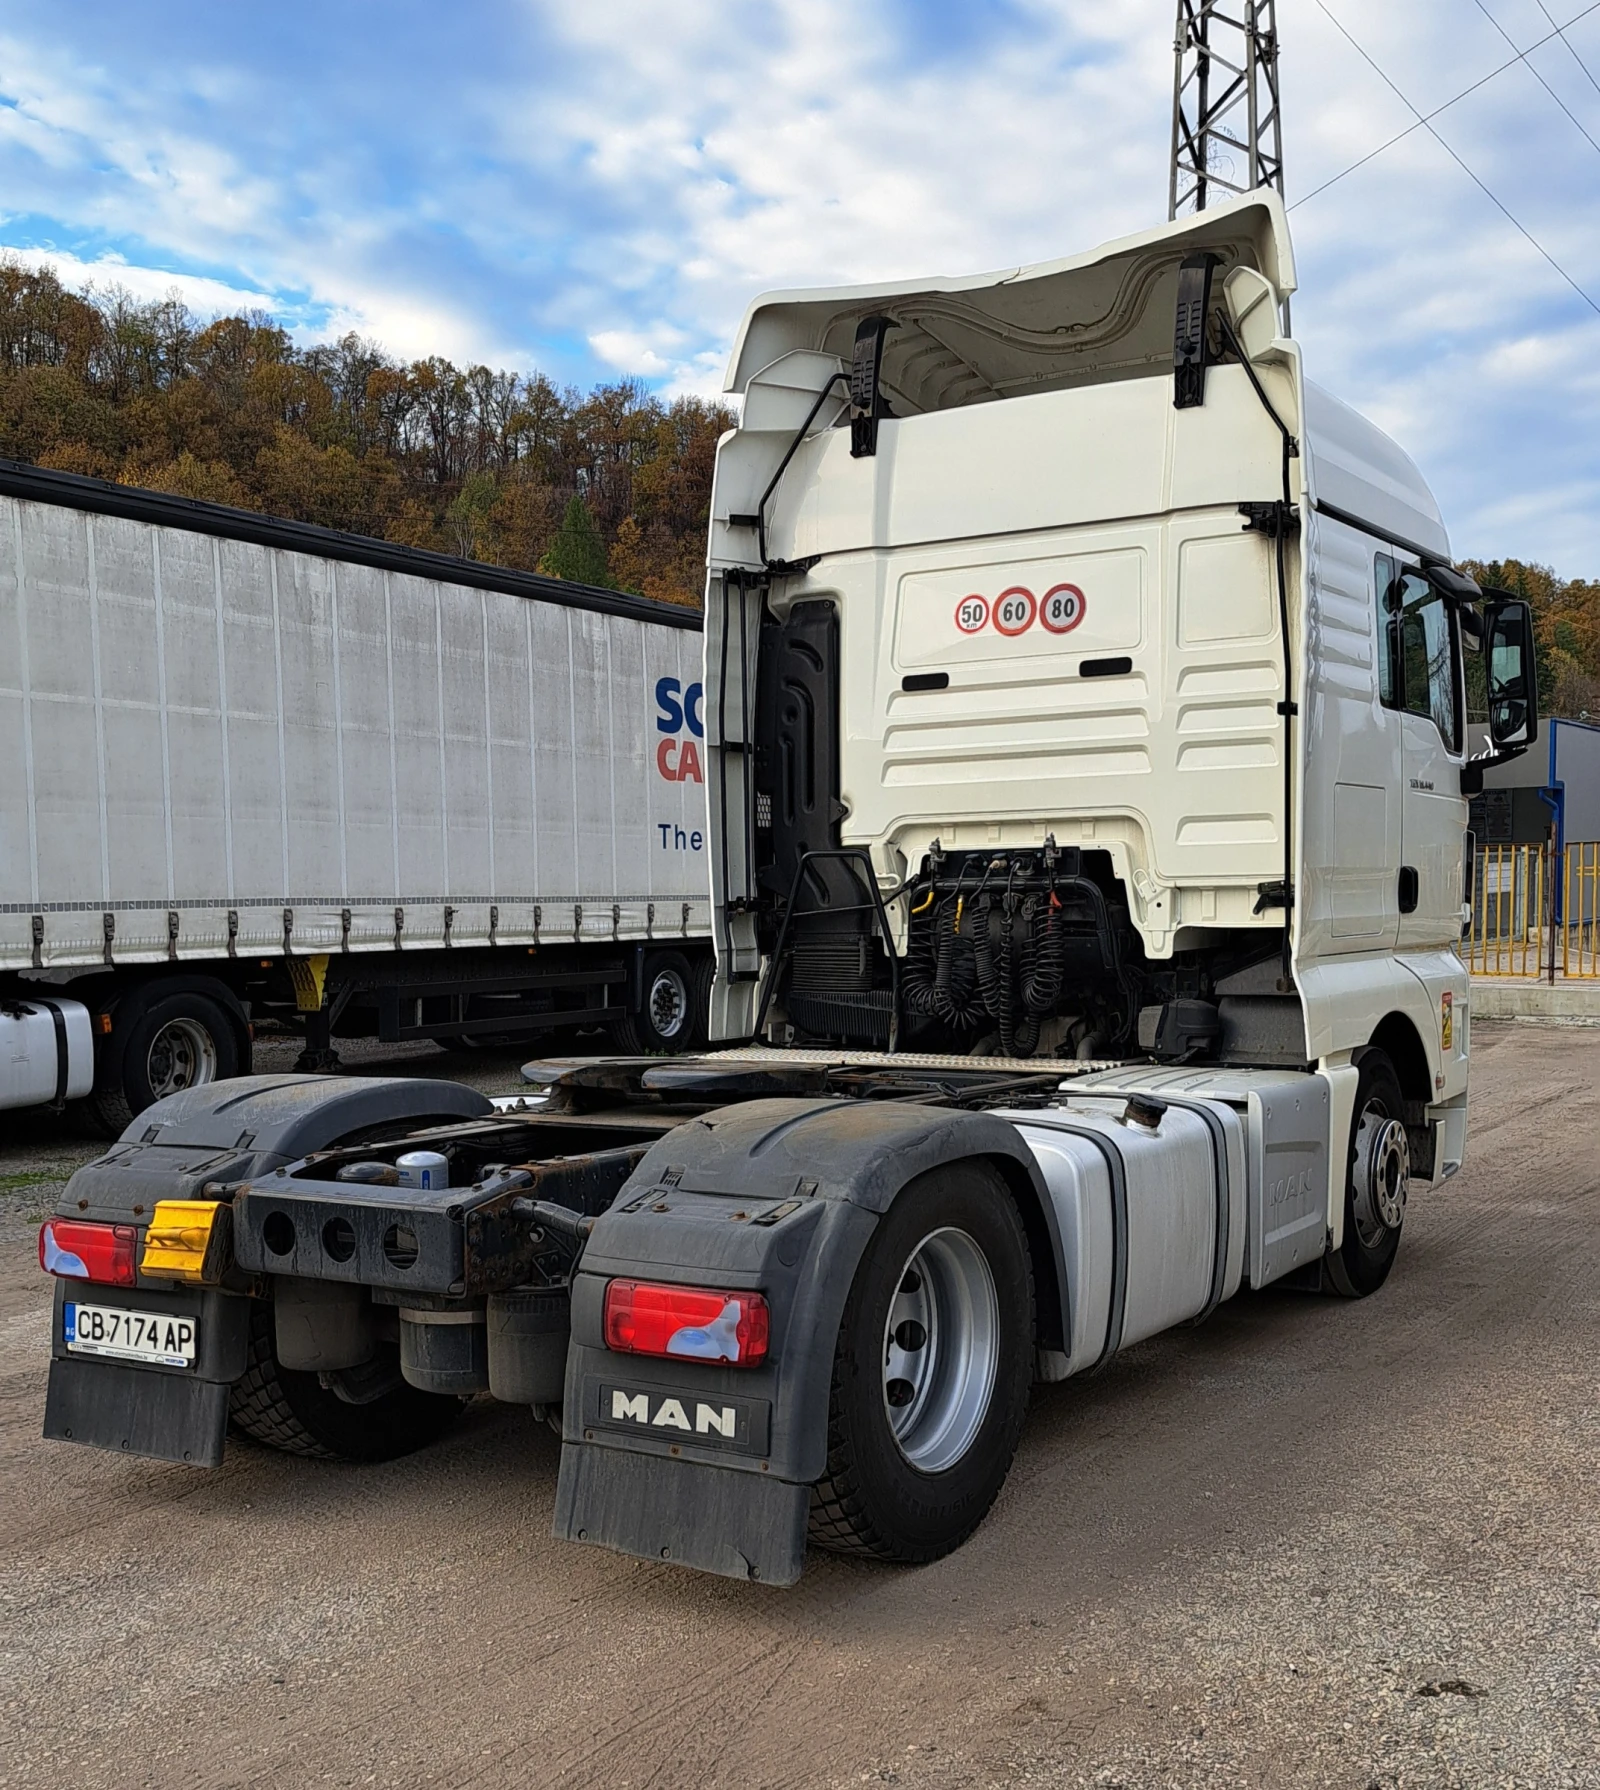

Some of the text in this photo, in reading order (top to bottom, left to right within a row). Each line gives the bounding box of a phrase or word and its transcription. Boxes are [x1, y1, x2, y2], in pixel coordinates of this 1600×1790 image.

[961, 604, 983, 623] 50
[1003, 601, 1026, 622] 60
[1051, 598, 1075, 619] 80
[657, 738, 705, 783] CA
[658, 823, 703, 850] The
[1269, 1168, 1313, 1207] MAN
[611, 1390, 736, 1438] MAN
